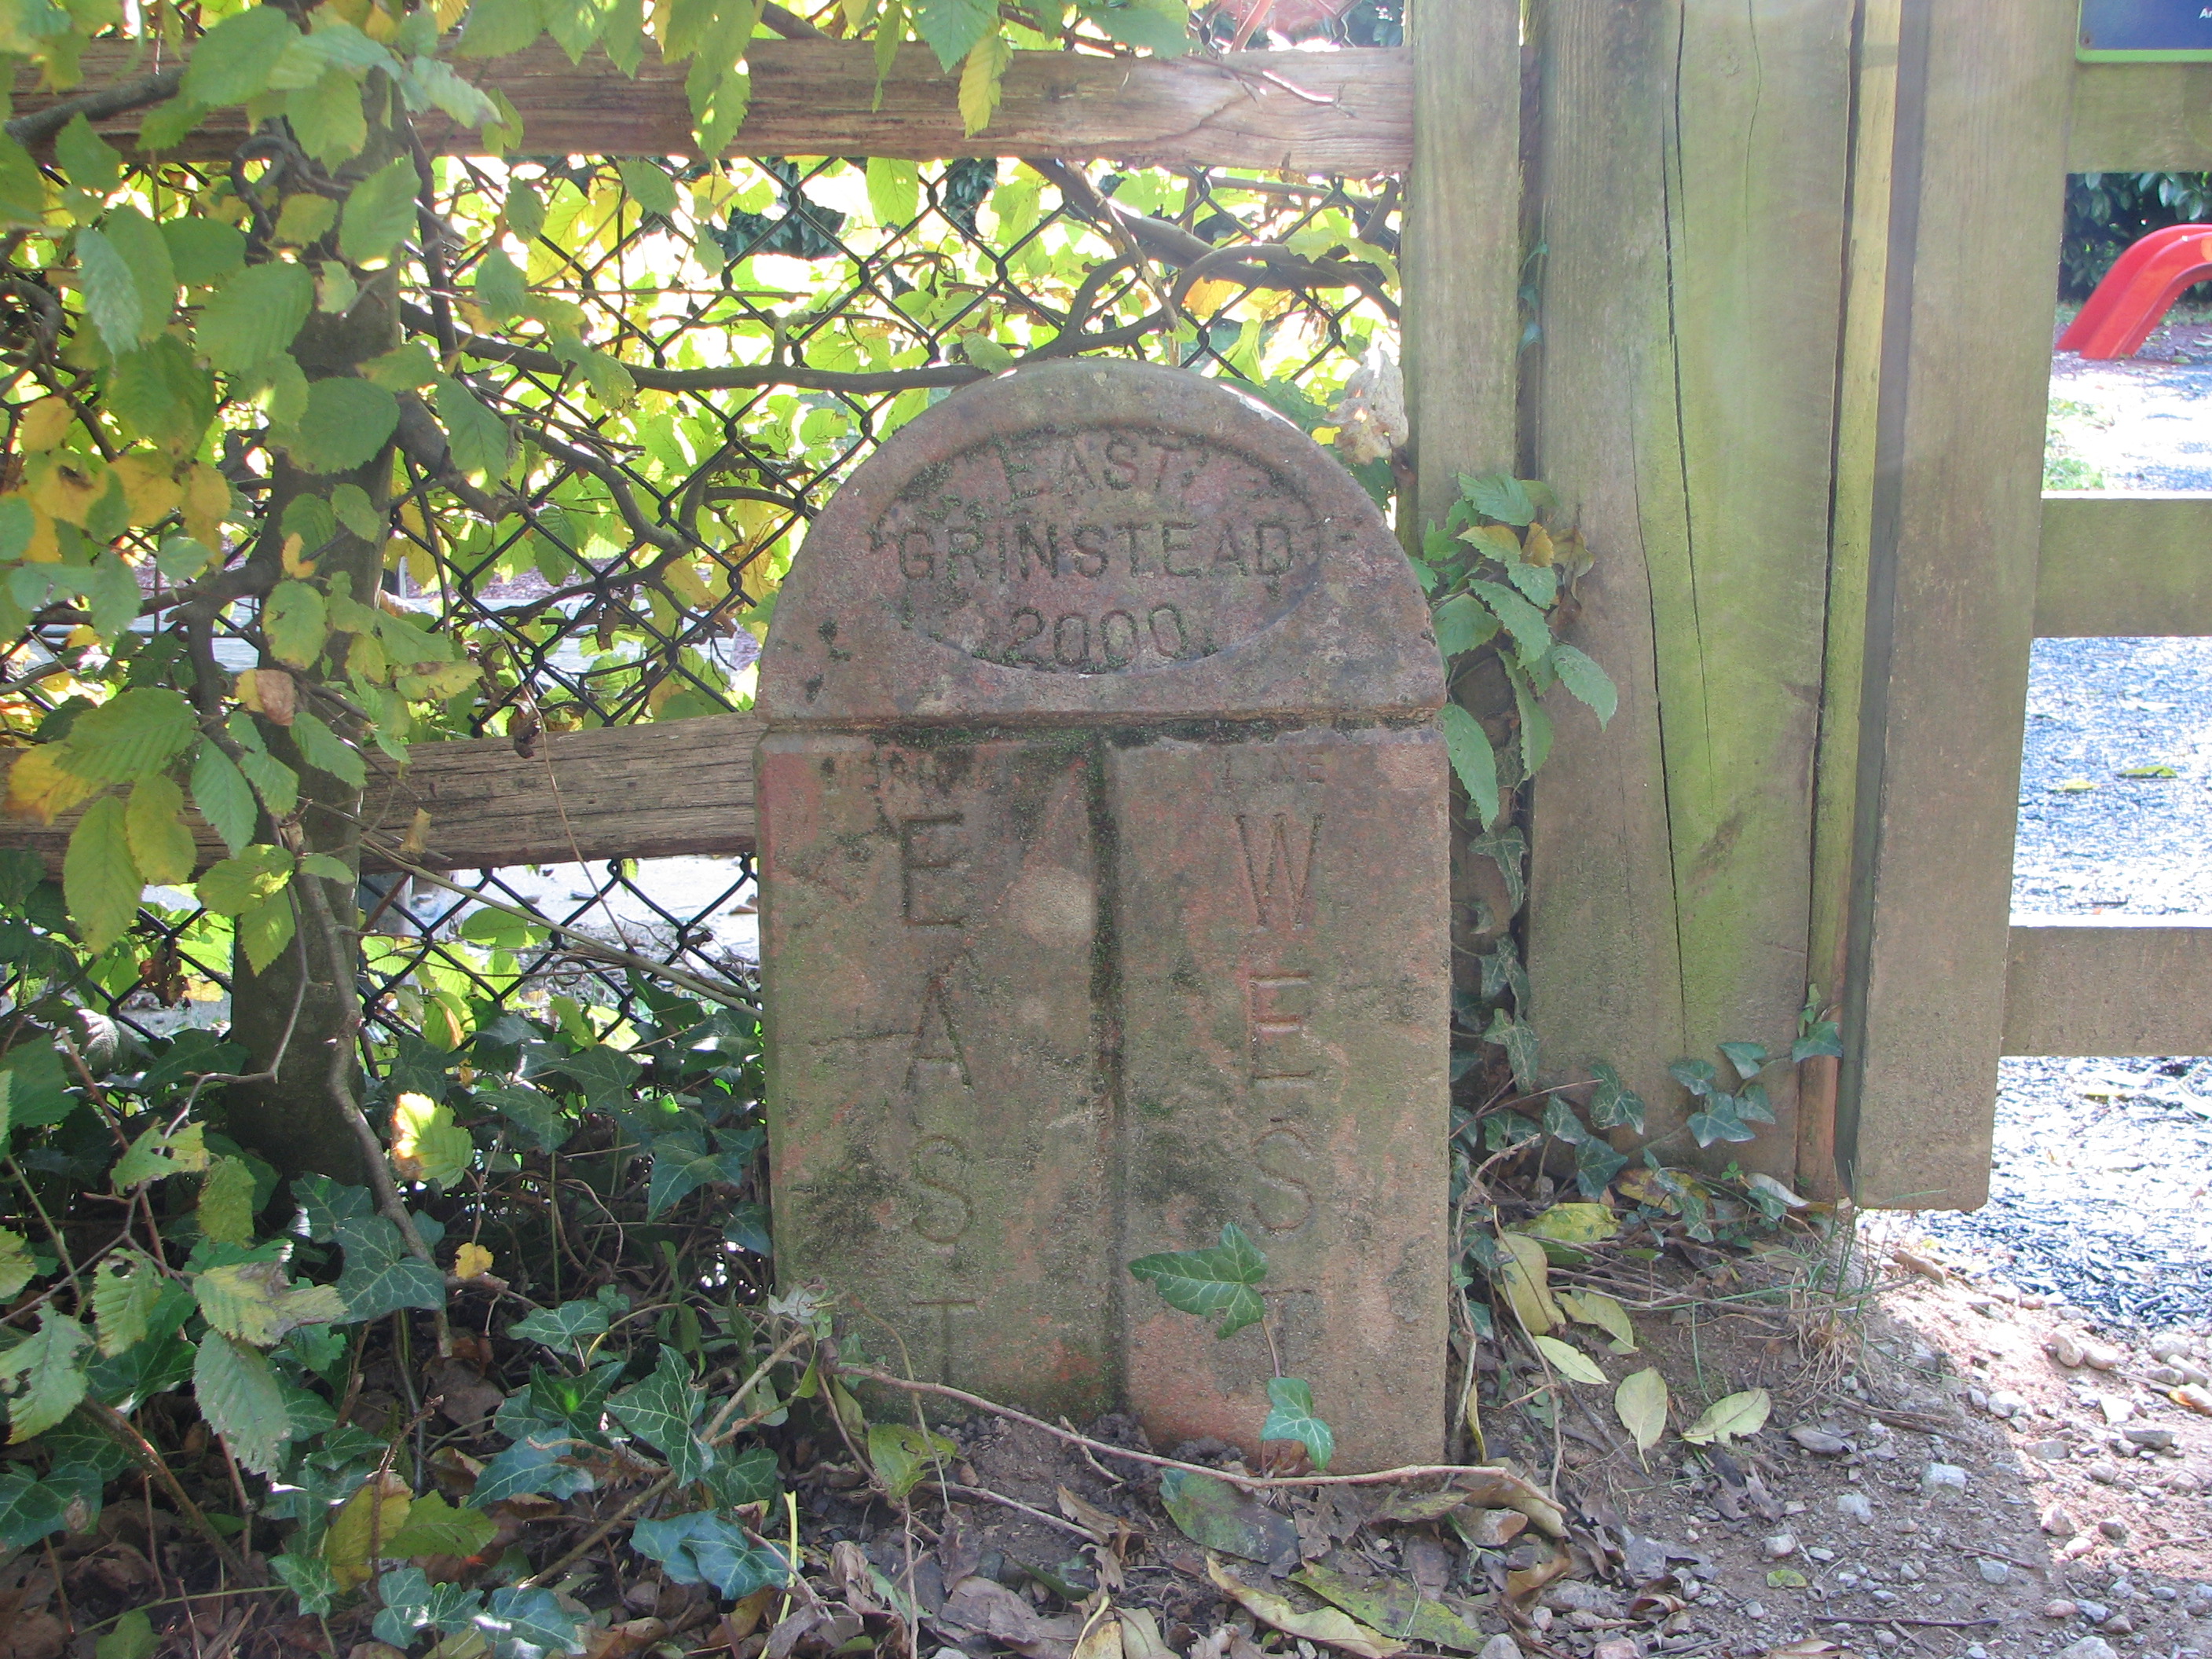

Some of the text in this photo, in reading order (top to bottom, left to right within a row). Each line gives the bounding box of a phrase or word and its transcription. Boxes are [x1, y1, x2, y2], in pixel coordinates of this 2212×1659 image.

[991, 431, 1183, 505] EAST
[899, 518, 1292, 585] GRINSTEAD
[1005, 602, 1189, 672] 2000
[901, 812, 979, 1394] EAST
[1233, 811, 1328, 1398] WEST
